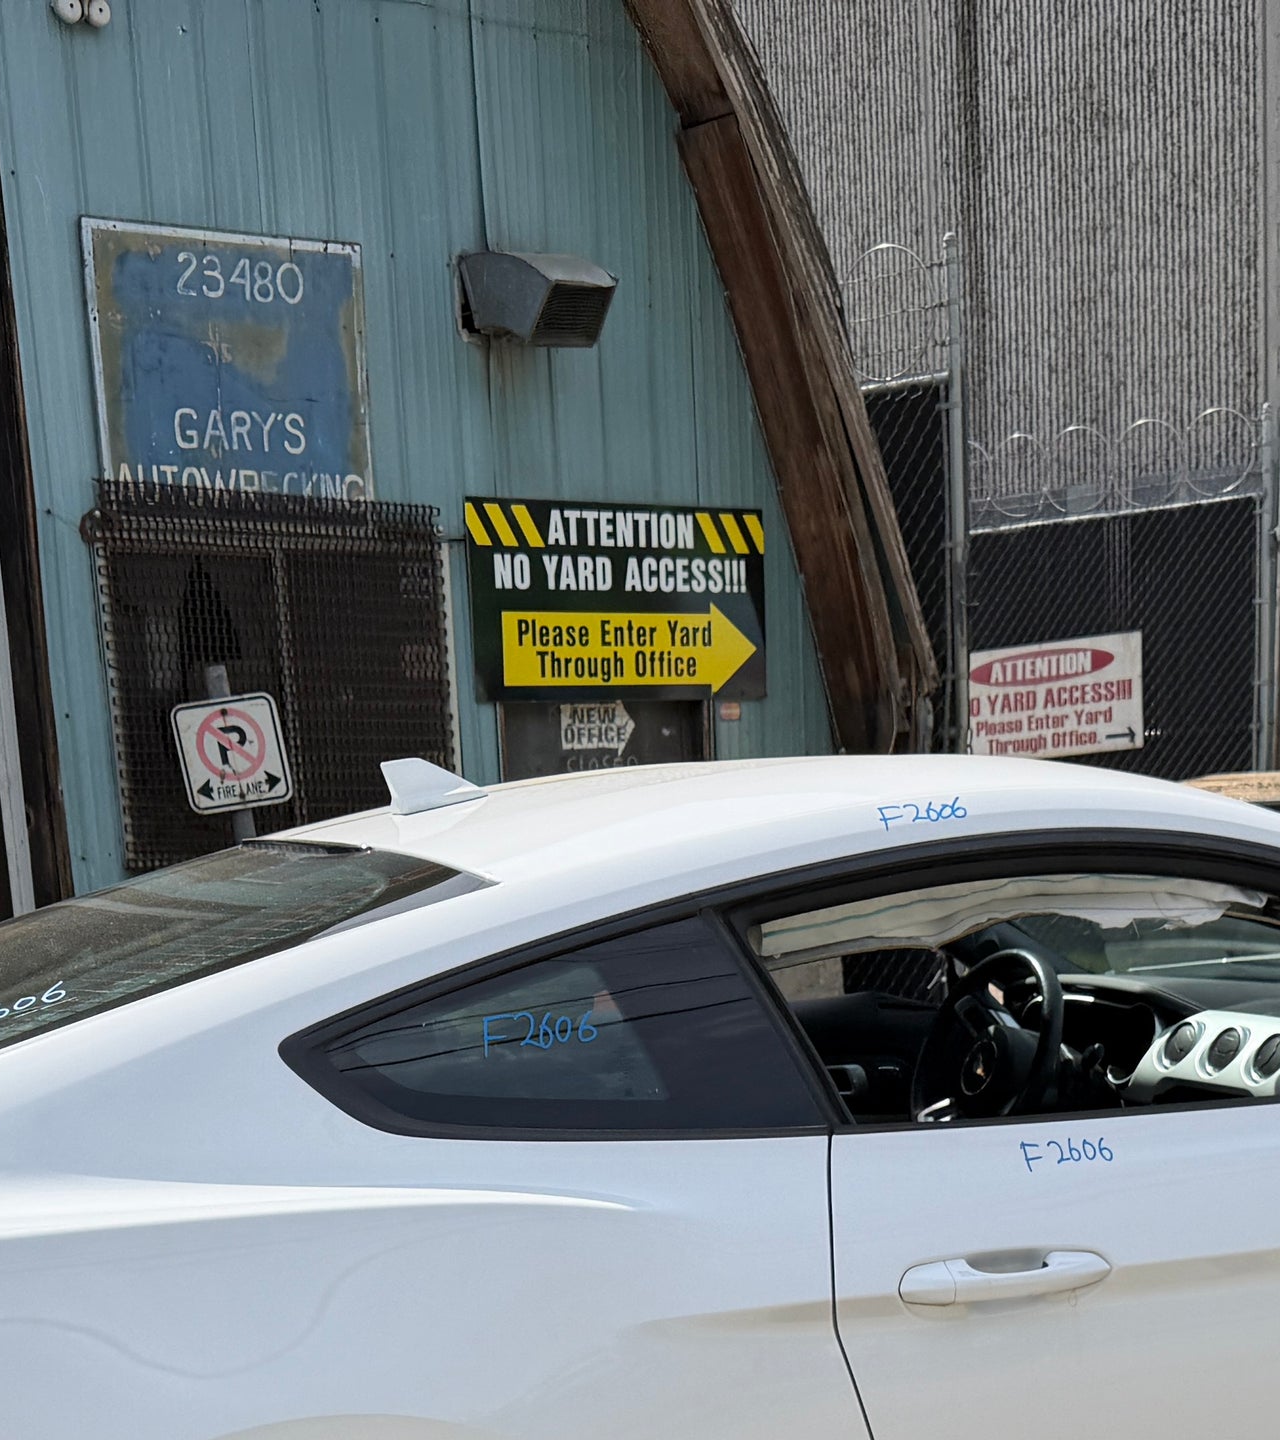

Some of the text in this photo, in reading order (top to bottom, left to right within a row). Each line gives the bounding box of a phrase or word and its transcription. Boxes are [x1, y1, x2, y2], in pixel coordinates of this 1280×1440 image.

[176, 251, 304, 304] 23480
[174, 407, 306, 455] GARY'S
[547, 508, 696, 549] ATTENTION
[493, 553, 748, 594] NO YARD ACCESS!!!
[517, 618, 713, 648] Please Enter Yard
[535, 650, 698, 683] Through Office
[989, 650, 1092, 684] ATTENTION
[987, 690, 1037, 715] YARD
[1043, 678, 1133, 709] ACCESS!!!
[571, 706, 617, 724] NEW
[976, 706, 1113, 737] Please Enter Yard
[564, 723, 627, 745] OFFICE
[988, 733, 1048, 755] Through
[217, 784, 238, 799] FIRE
[877, 796, 967, 832] F2606
[482, 1010, 599, 1058] F2606
[1020, 1137, 1113, 1172] F2606
